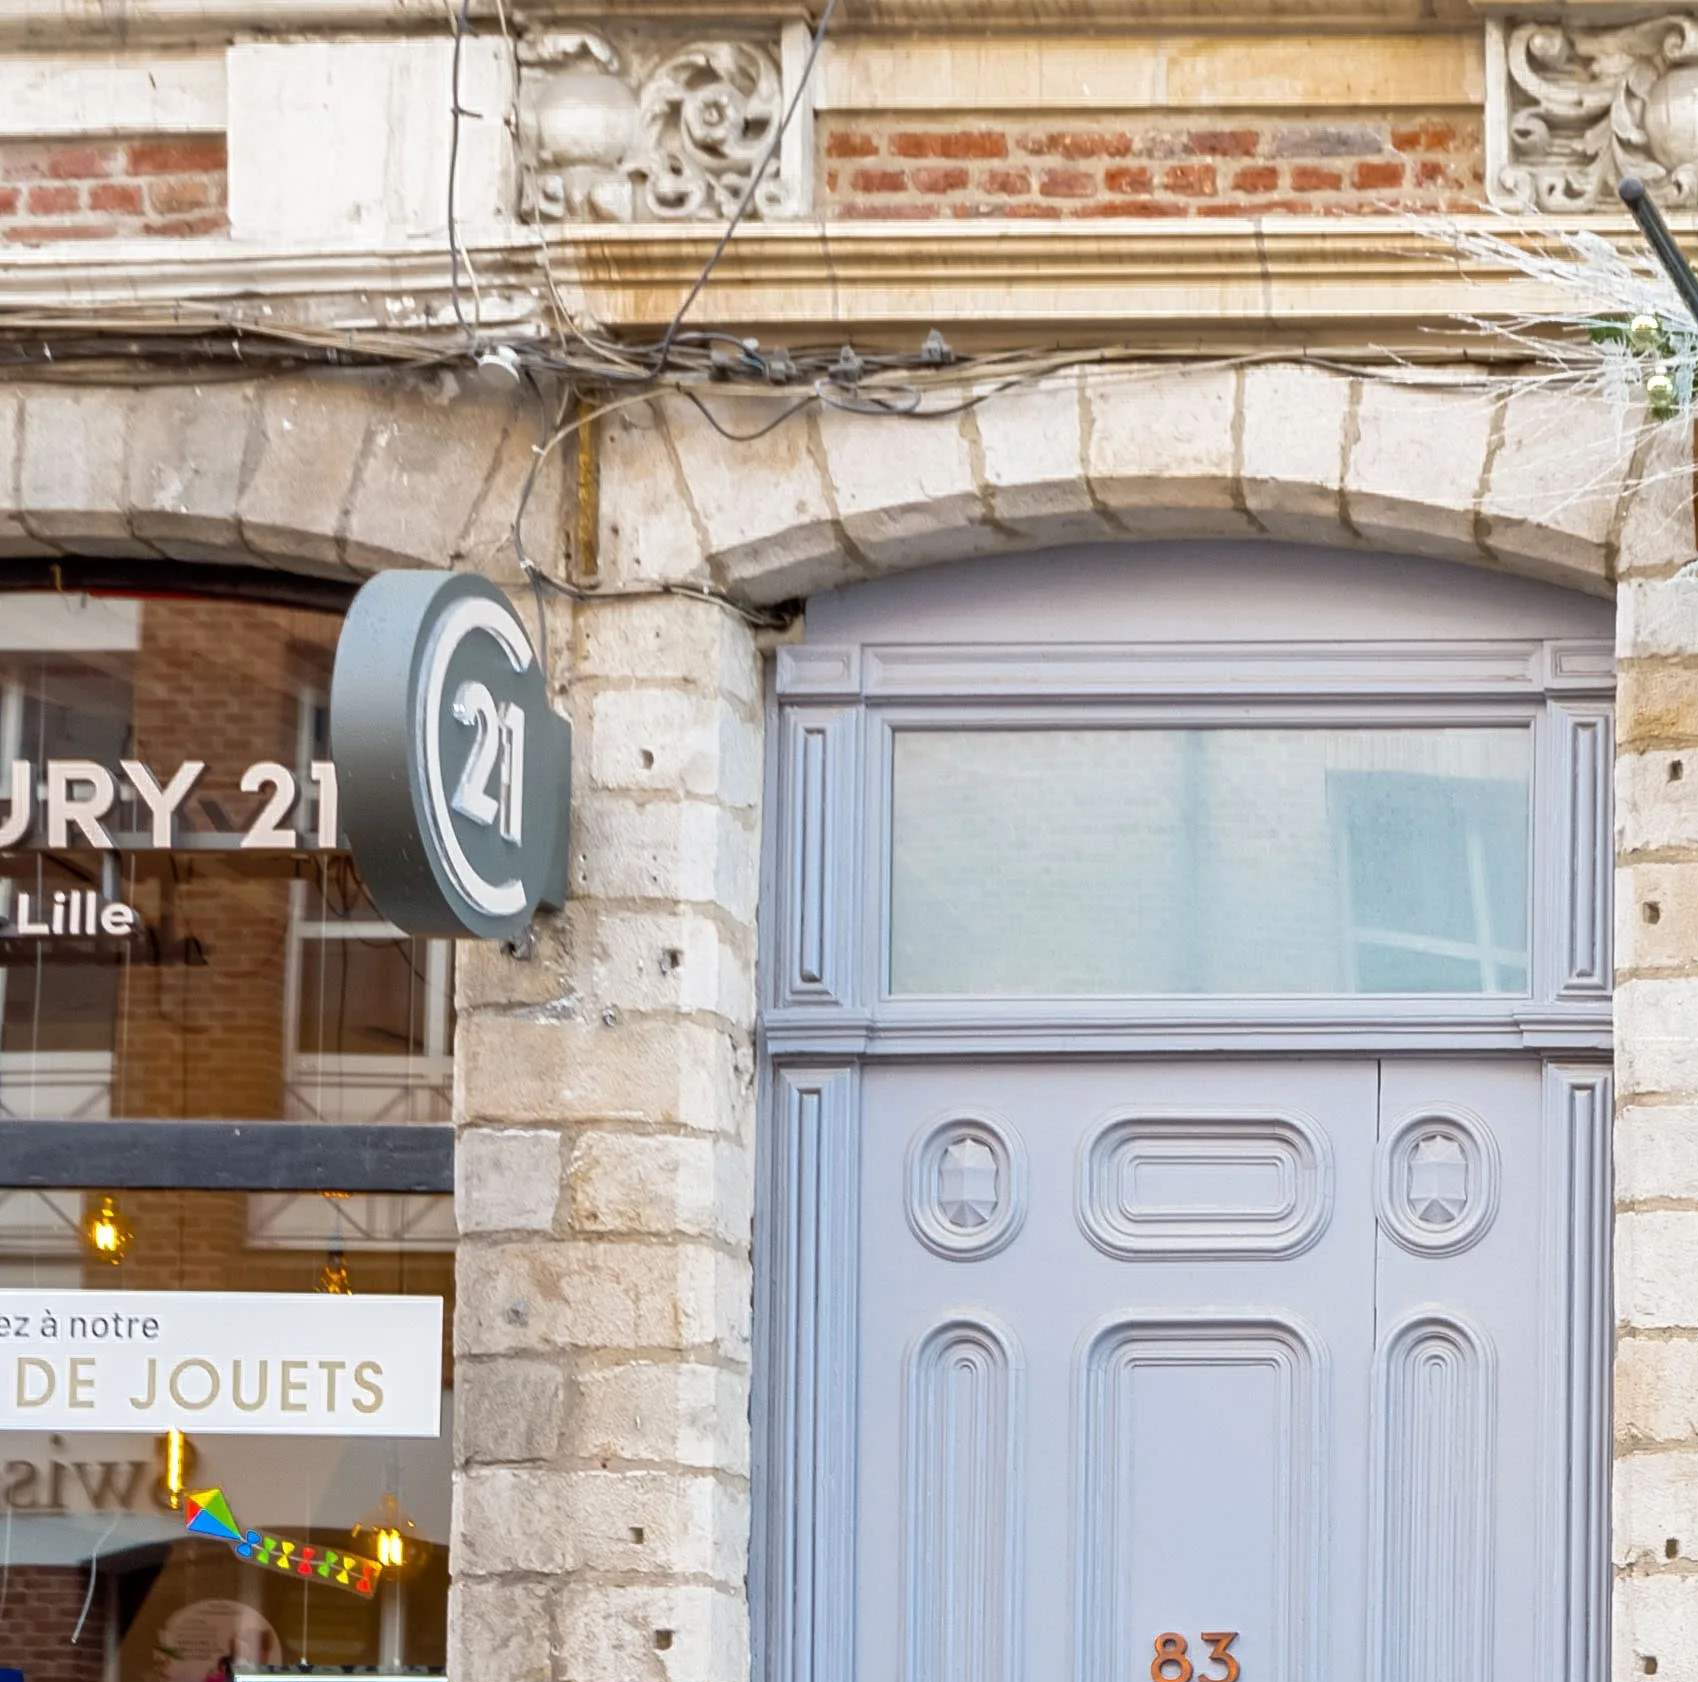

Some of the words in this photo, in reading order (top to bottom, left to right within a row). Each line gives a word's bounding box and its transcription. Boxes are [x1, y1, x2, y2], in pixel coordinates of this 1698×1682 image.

[240, 760, 338, 849] 21
[17, 890, 136, 936] Lille
[42, 1308, 57, 1338] à
[71, 1311, 160, 1339] notre
[16, 1357, 98, 1410] DE
[130, 1358, 386, 1414] JOUETS
